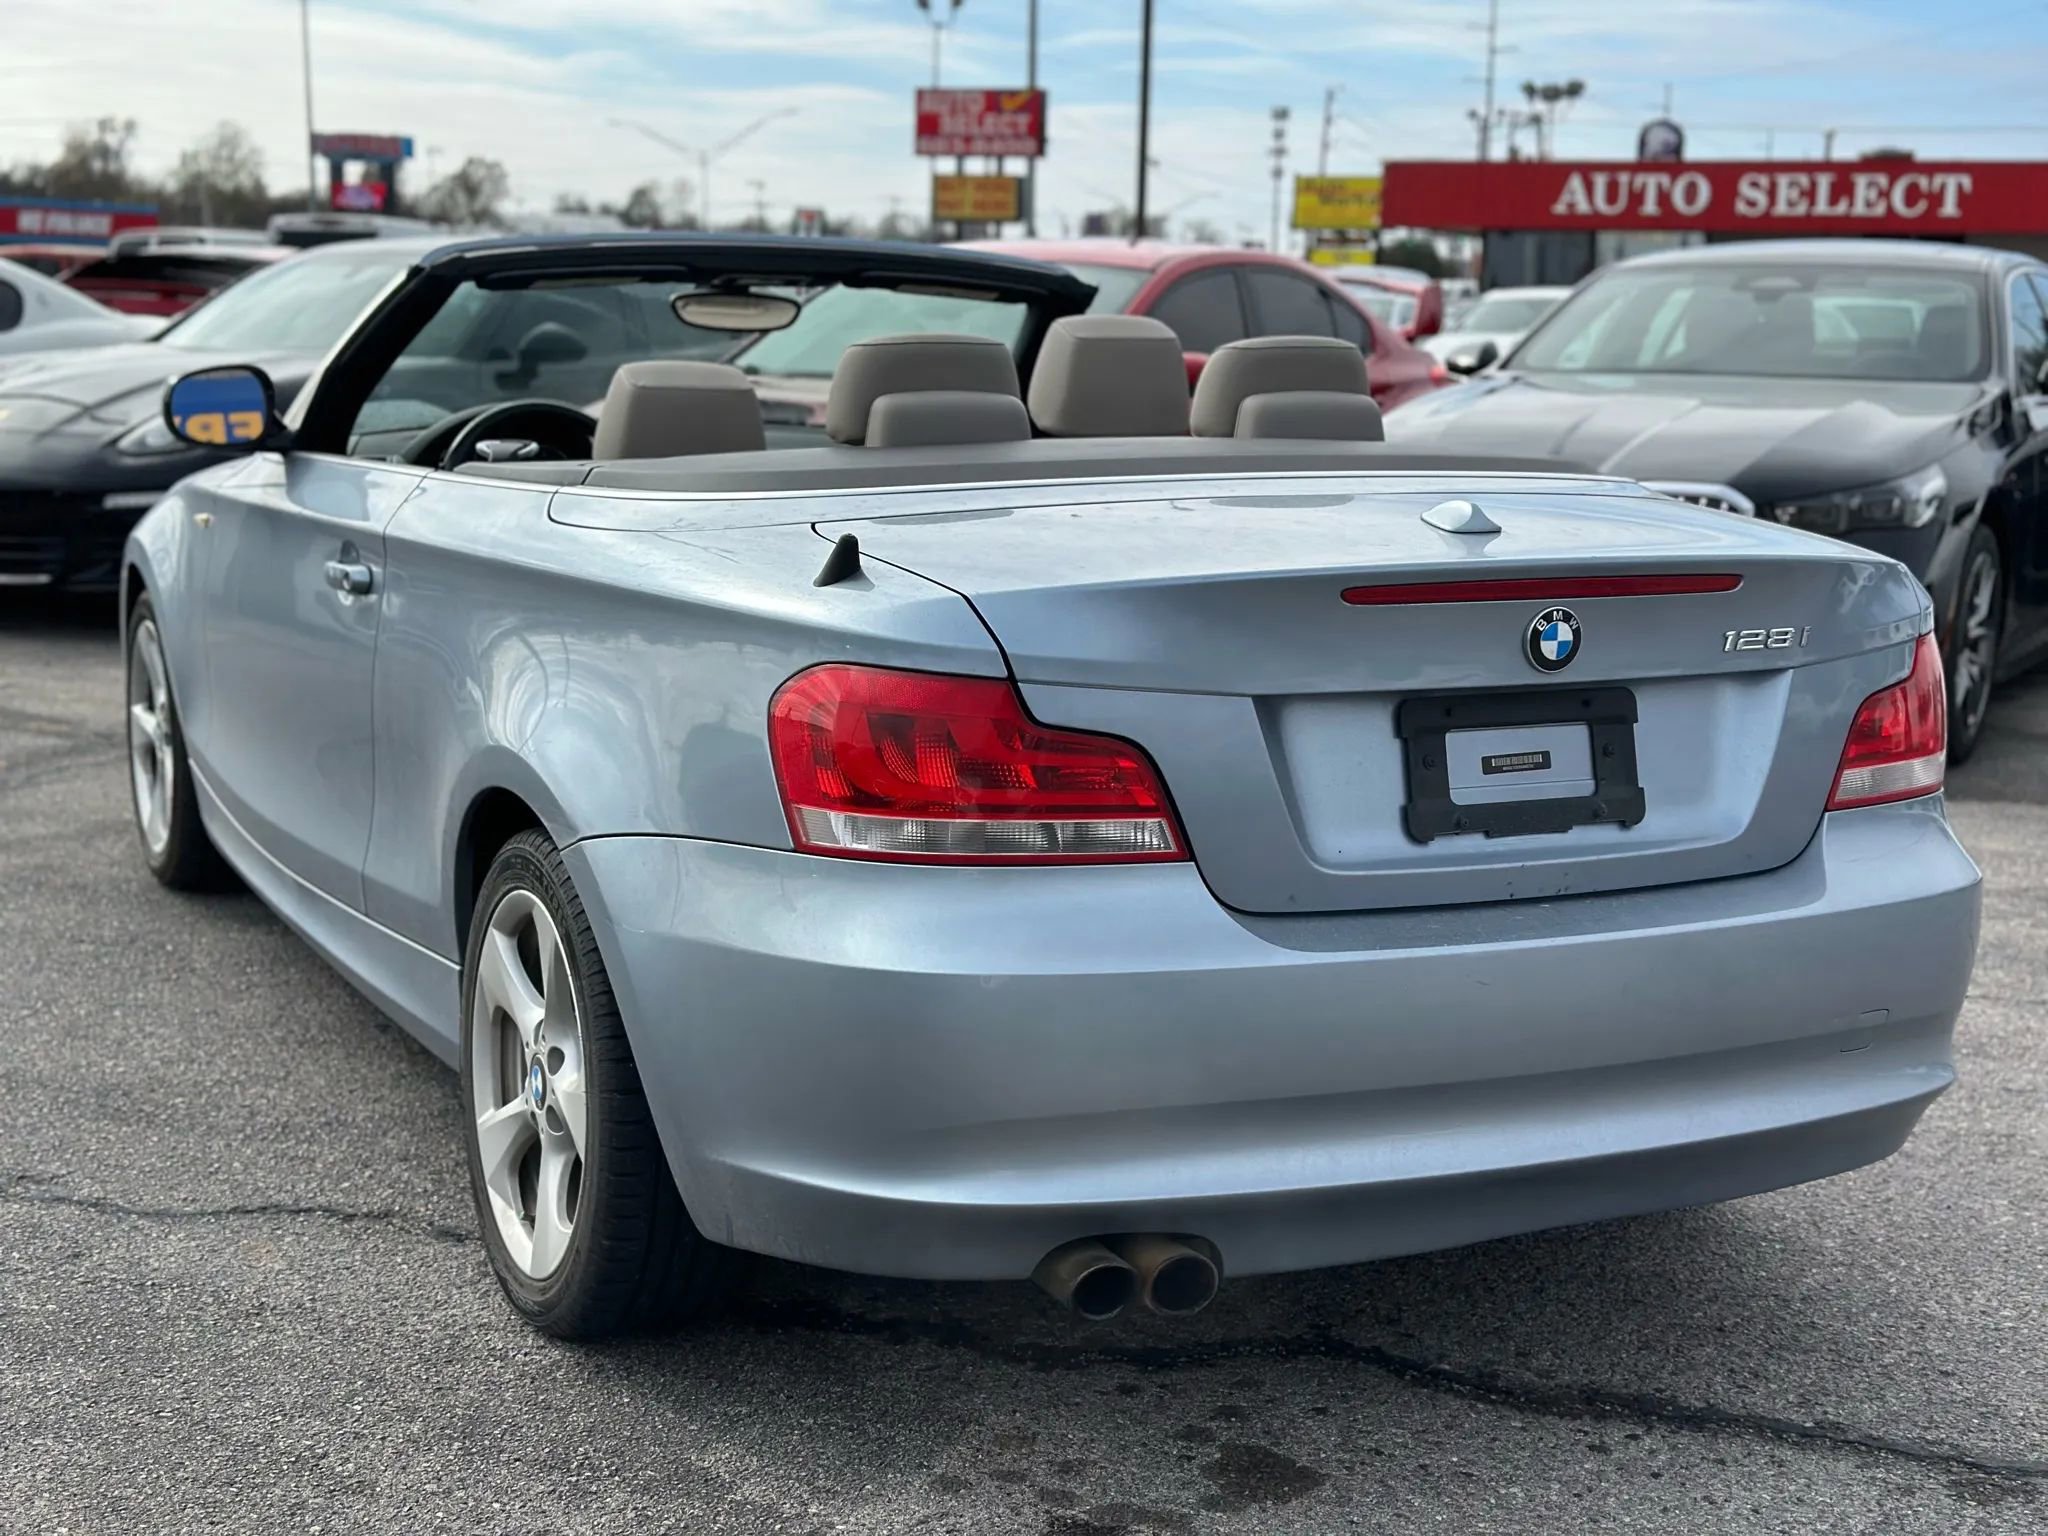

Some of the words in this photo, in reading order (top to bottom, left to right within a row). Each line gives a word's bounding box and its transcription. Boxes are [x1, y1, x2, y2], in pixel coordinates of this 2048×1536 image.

[1550, 170, 1713, 217] AUTO
[1734, 171, 1973, 219] SELECT
[1536, 610, 1579, 631] BMW
[1723, 626, 1812, 652] 128i
